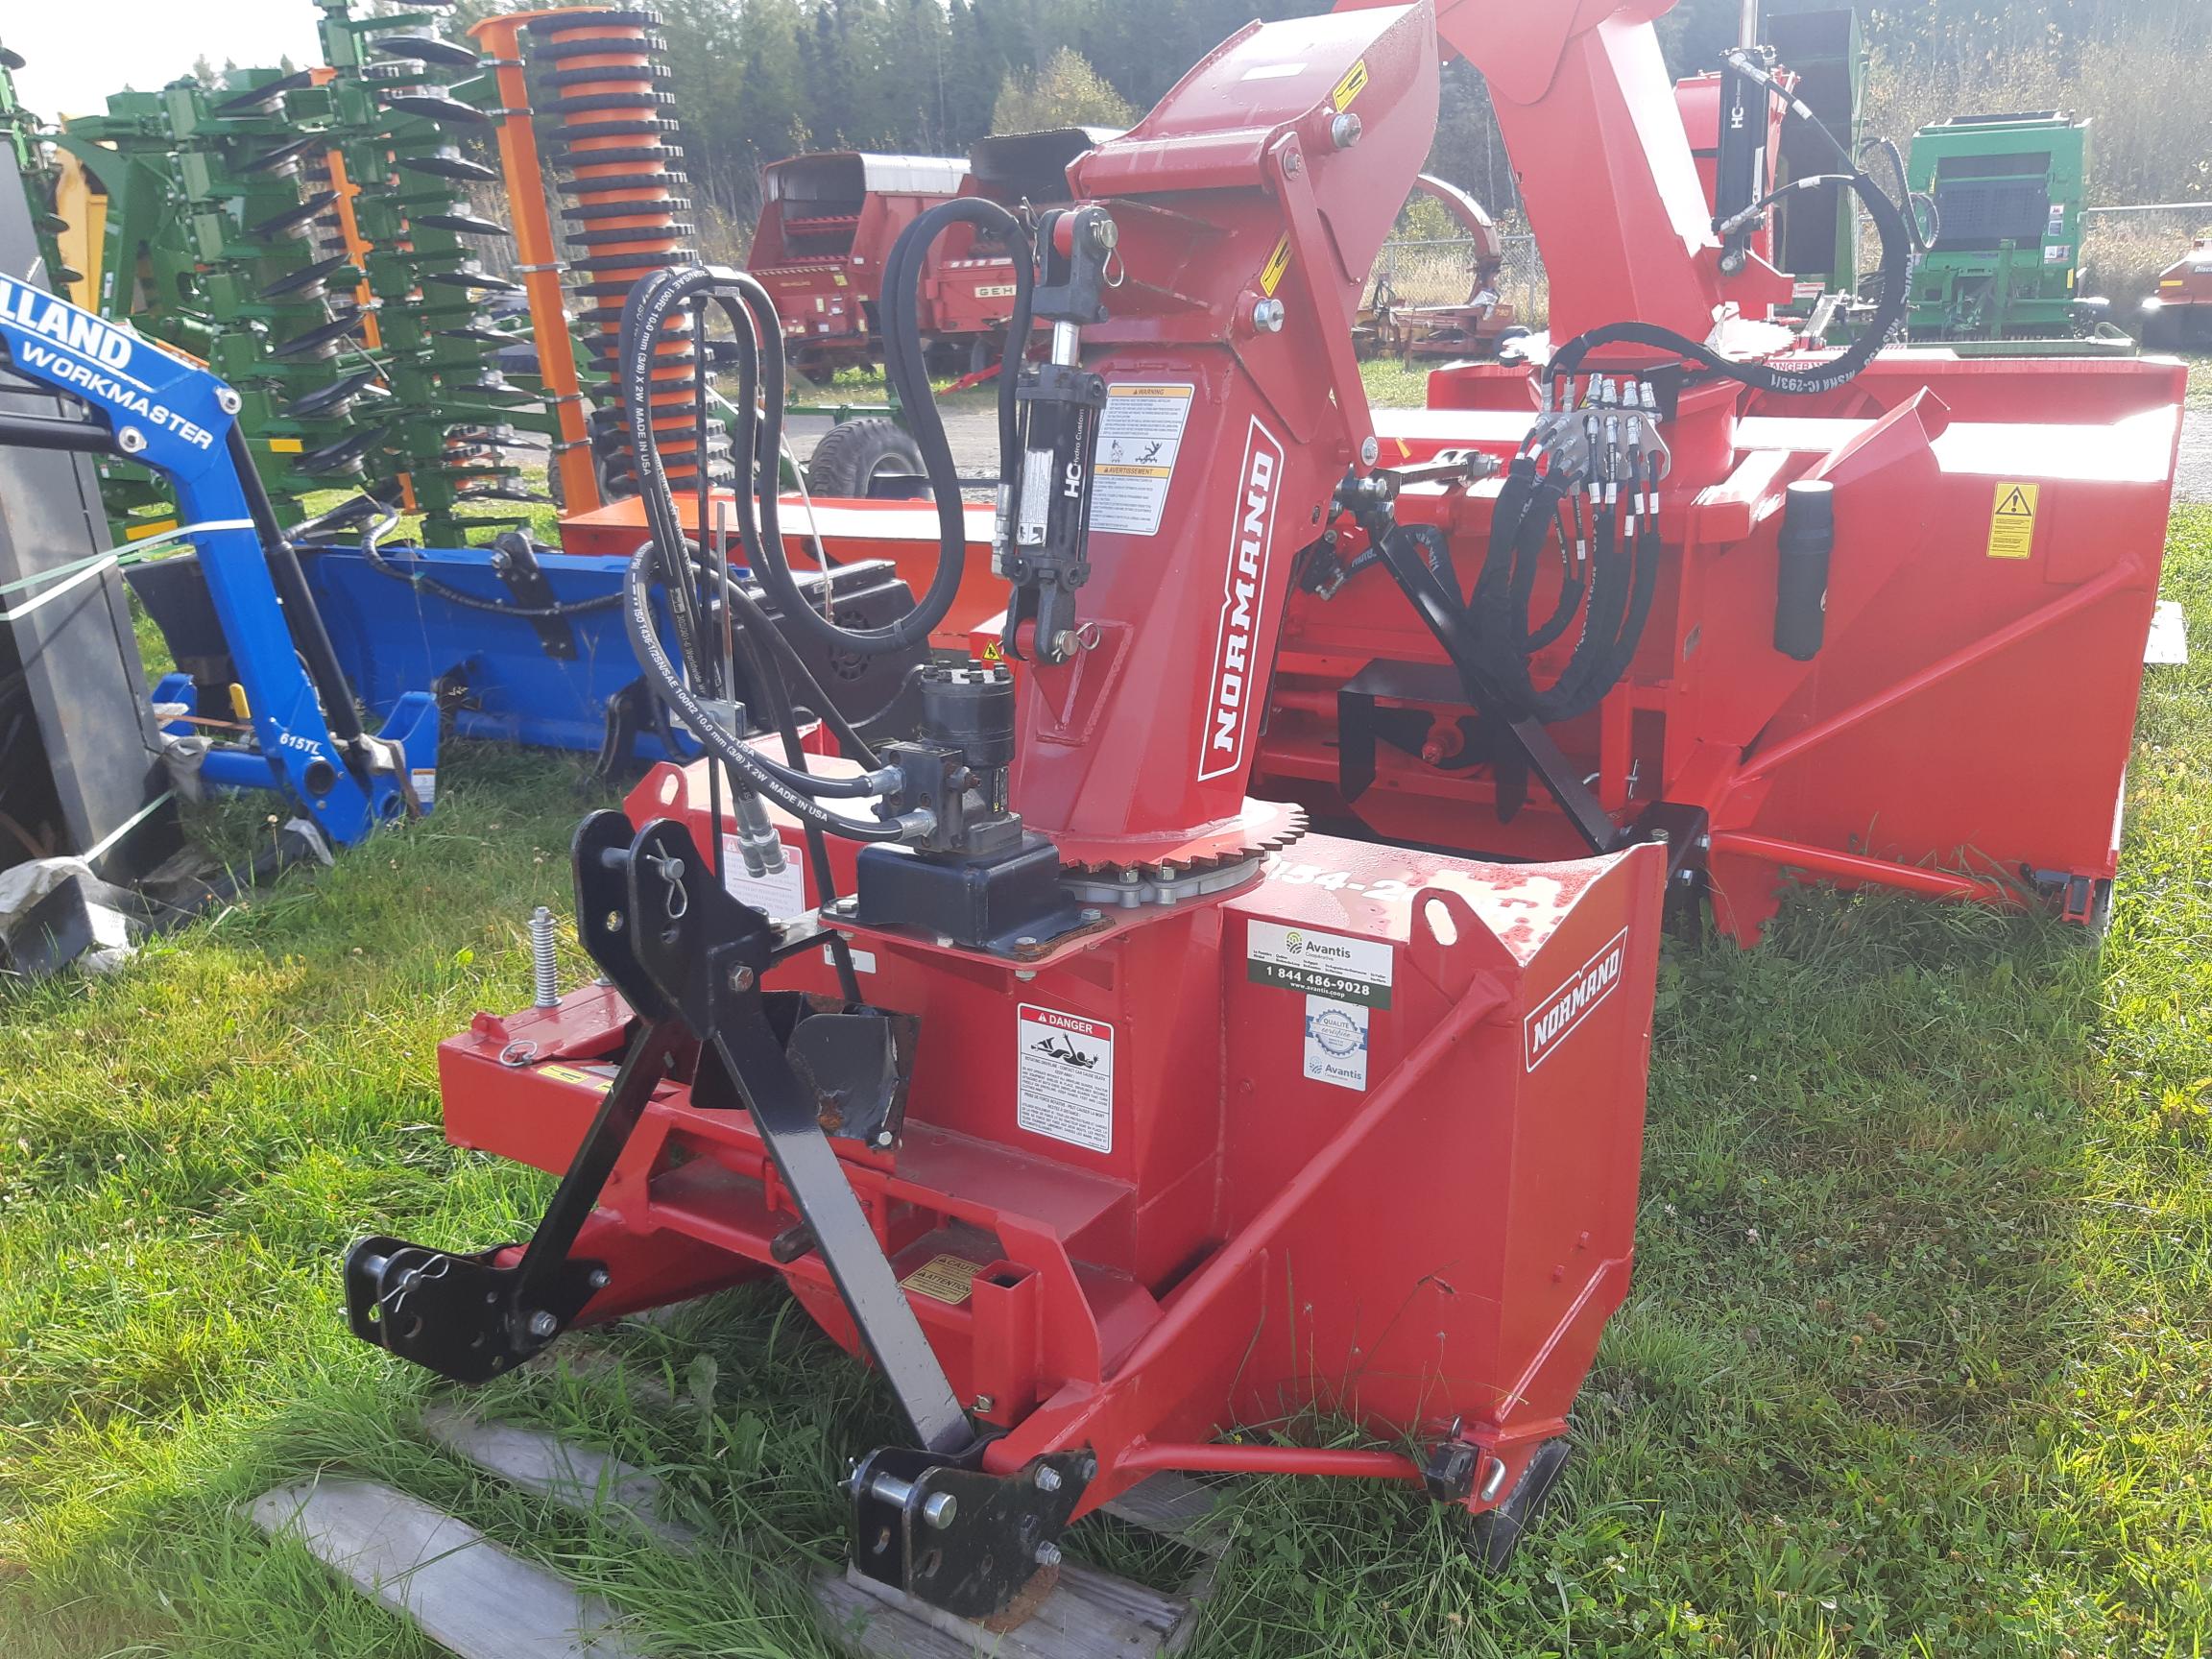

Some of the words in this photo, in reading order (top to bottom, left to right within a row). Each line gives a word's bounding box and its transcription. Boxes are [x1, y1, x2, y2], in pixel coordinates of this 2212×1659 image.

[1731, 107, 1743, 129] HC
[654, 288, 675, 312] 100R2
[979, 287, 1013, 297] GEH
[646, 313, 659, 331] 10.0
[639, 329, 654, 350] mm
[637, 352, 648, 373] (3/8)
[636, 375, 644, 384] X
[22, 341, 214, 450] WORKMASTER
[636, 386, 644, 402] 2W
[636, 407, 646, 440] MADE
[1075, 408, 1084, 441] Custom
[638, 441, 648, 452] IN
[640, 453, 652, 476] USA
[1064, 462, 1081, 498] HC
[1214, 450, 1274, 753] NORMAND
[634, 609, 643, 623] ISO
[638, 623, 678, 688] 1436-1/2SN/SAE
[675, 687, 699, 714] 100R2
[696, 714, 713, 732] 10.0
[279, 733, 323, 756] 615TL
[711, 730, 727, 748] mm
[736, 741, 756, 757] USA
[727, 745, 746, 765] (3/8)
[744, 760, 754, 771] X
[752, 768, 768, 783] 2W
[769, 781, 797, 804] MADE
[796, 799, 807, 810] IN
[808, 805, 829, 822] USA
[1306, 941, 1352, 959] Avantis
[1266, 966, 1272, 975] 1
[1278, 968, 1302, 981] 844
[1307, 974, 1370, 996] 486-9028
[1290, 981, 1345, 998] www.avantis.coop
[1532, 948, 1620, 1054] NORMAND
[1048, 1014, 1093, 1034] DANGER
[1325, 1064, 1361, 1080] Avantis
[946, 1260, 978, 1273] CAUTI
[925, 1272, 971, 1292] ATTENTION
